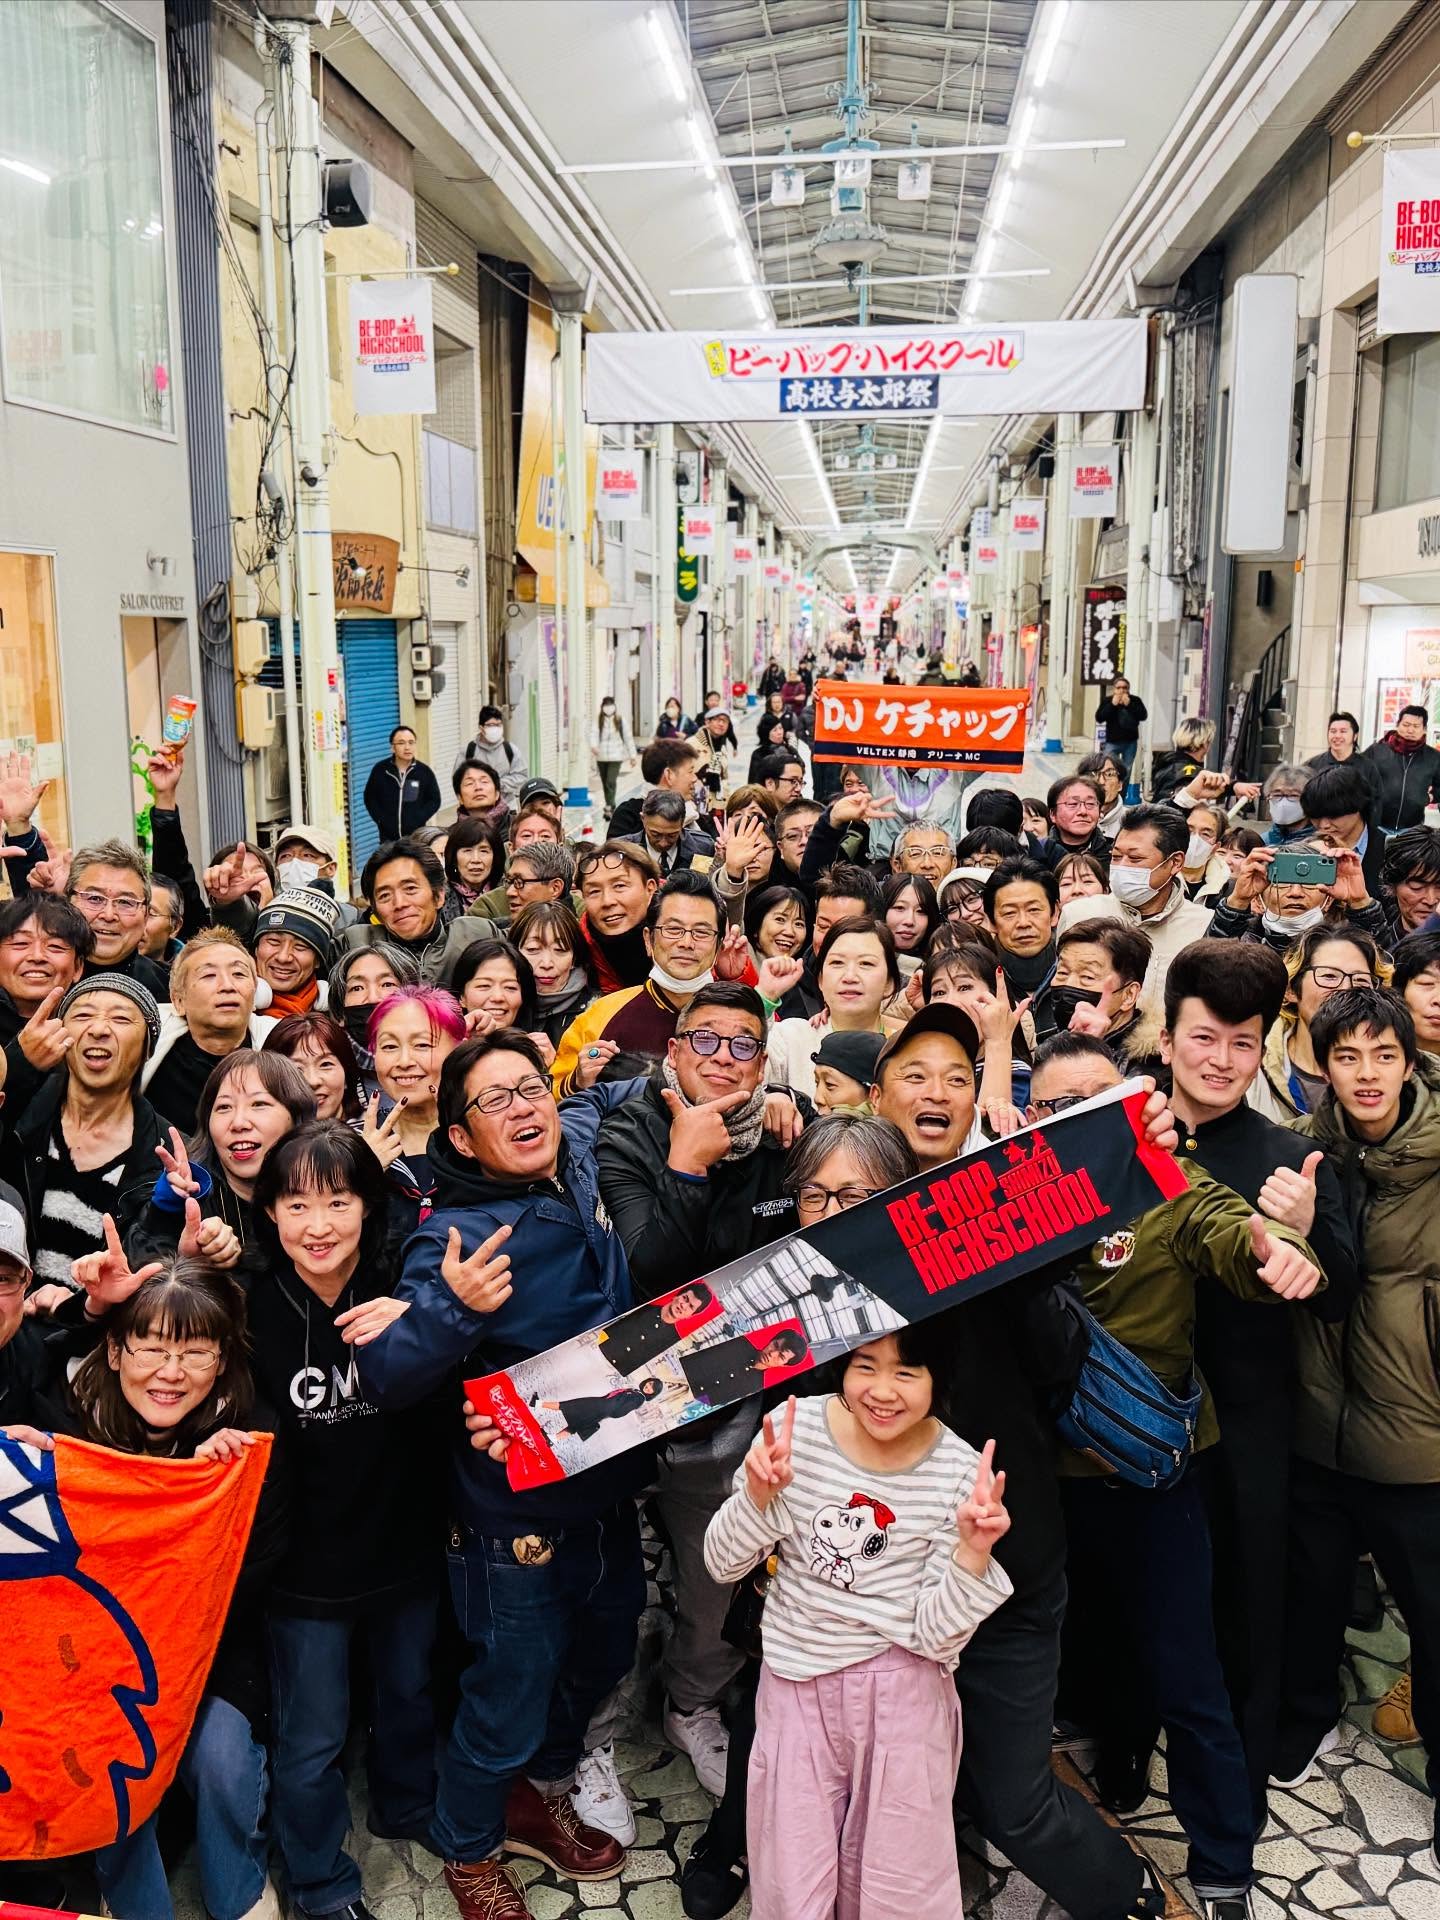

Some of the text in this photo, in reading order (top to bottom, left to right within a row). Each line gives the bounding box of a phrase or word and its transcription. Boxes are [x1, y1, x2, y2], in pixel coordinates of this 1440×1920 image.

[359, 319, 396, 336] BE-BOP
[360, 335, 425, 355] HIGHSCHOOL
[120, 593, 184, 611] SALON COFFRET
[822, 697, 1025, 741] DJ ケチャップ
[857, 746, 895, 757] VELTEX
[927, 752, 962, 761] アリーナ
[965, 752, 981, 761] MC
[998, 1154, 1063, 1197] SHIMIZU
[886, 1160, 998, 1249] BE-BOP
[908, 1167, 1111, 1295] HIGHSCHOOL
